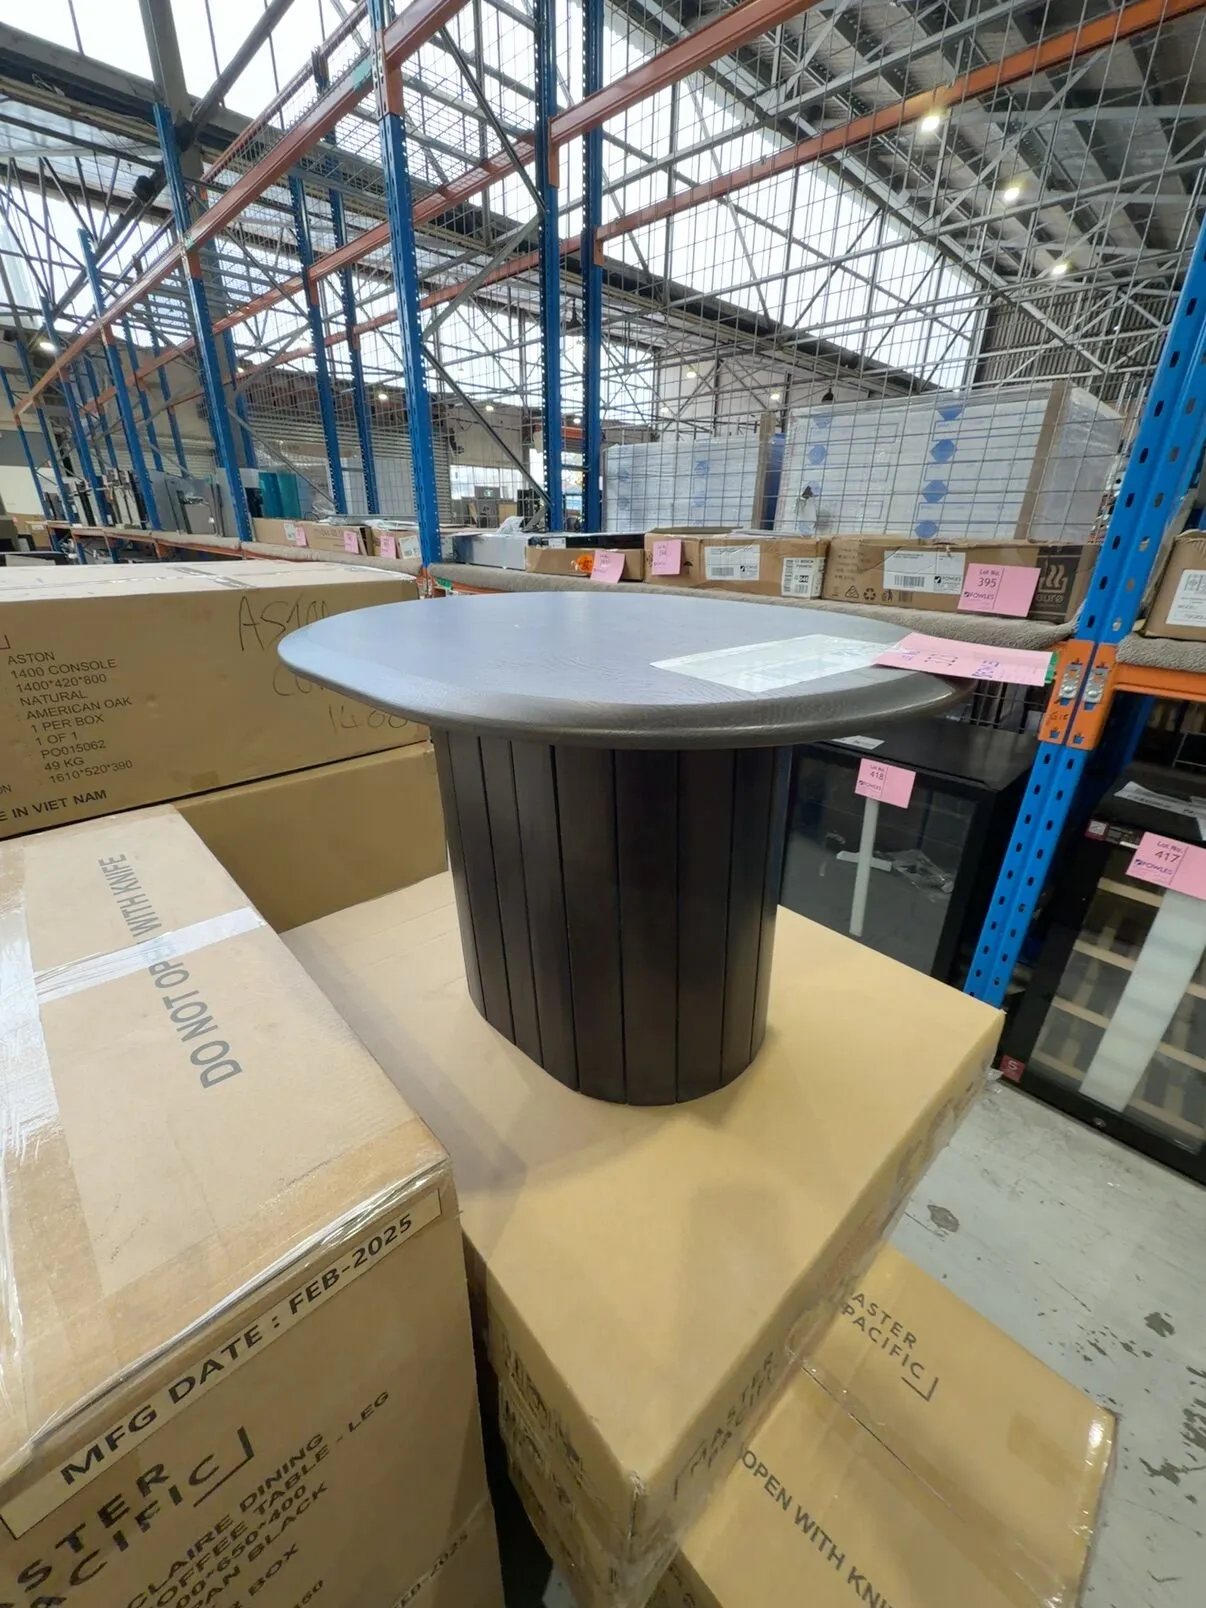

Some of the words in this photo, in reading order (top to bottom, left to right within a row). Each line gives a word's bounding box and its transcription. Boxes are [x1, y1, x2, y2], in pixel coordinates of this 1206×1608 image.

[969, 591, 995, 600] FOWLES
[978, 577, 997, 588] 395
[8, 651, 56, 665] ASTON
[10, 667, 45, 680] 1400
[48, 658, 117, 676] CONSOLE
[19, 691, 88, 707] NATURAL
[26, 700, 100, 720] AMERICAN
[104, 697, 132, 709] OAK
[42, 719, 73, 732] PER
[76, 714, 105, 727] BOX
[40, 740, 107, 759] PO015062
[47, 732, 67, 745] OF
[44, 761, 60, 771] 49
[64, 756, 85, 768] KG
[870, 770, 884, 780] 418
[12, 806, 29, 819] IN
[31, 797, 68, 814] VIET
[73, 789, 107, 805] NAM
[1141, 861, 1173, 875] FOWLES
[1155, 851, 1180, 863] 417
[98, 853, 142, 896] KNIFE
[116, 893, 163, 938] WITH
[148, 960, 190, 989] OP
[162, 989, 219, 1042] NOT
[189, 1039, 243, 1089] DO
[852, 1293, 917, 1350] ASTER
[60, 1404, 158, 1485] MFG
[167, 1325, 263, 1405] DATE
[289, 1213, 413, 1316] FEB-2025
[841, 1303, 925, 1380] PACIFIC
[150, 1521, 248, 1608] OFFEE
[252, 1445, 331, 1517] TABLE
[348, 1391, 390, 1433] LEG
[741, 1450, 793, 1511] OPEN
[794, 1505, 846, 1571] WITH
[127, 1514, 234, 1608] CLAIRE
[239, 1433, 324, 1513] DINING
[247, 1481, 329, 1563] BLACK
[0, 1463, 170, 1608] STER
[248, 1543, 299, 1597] BOX
